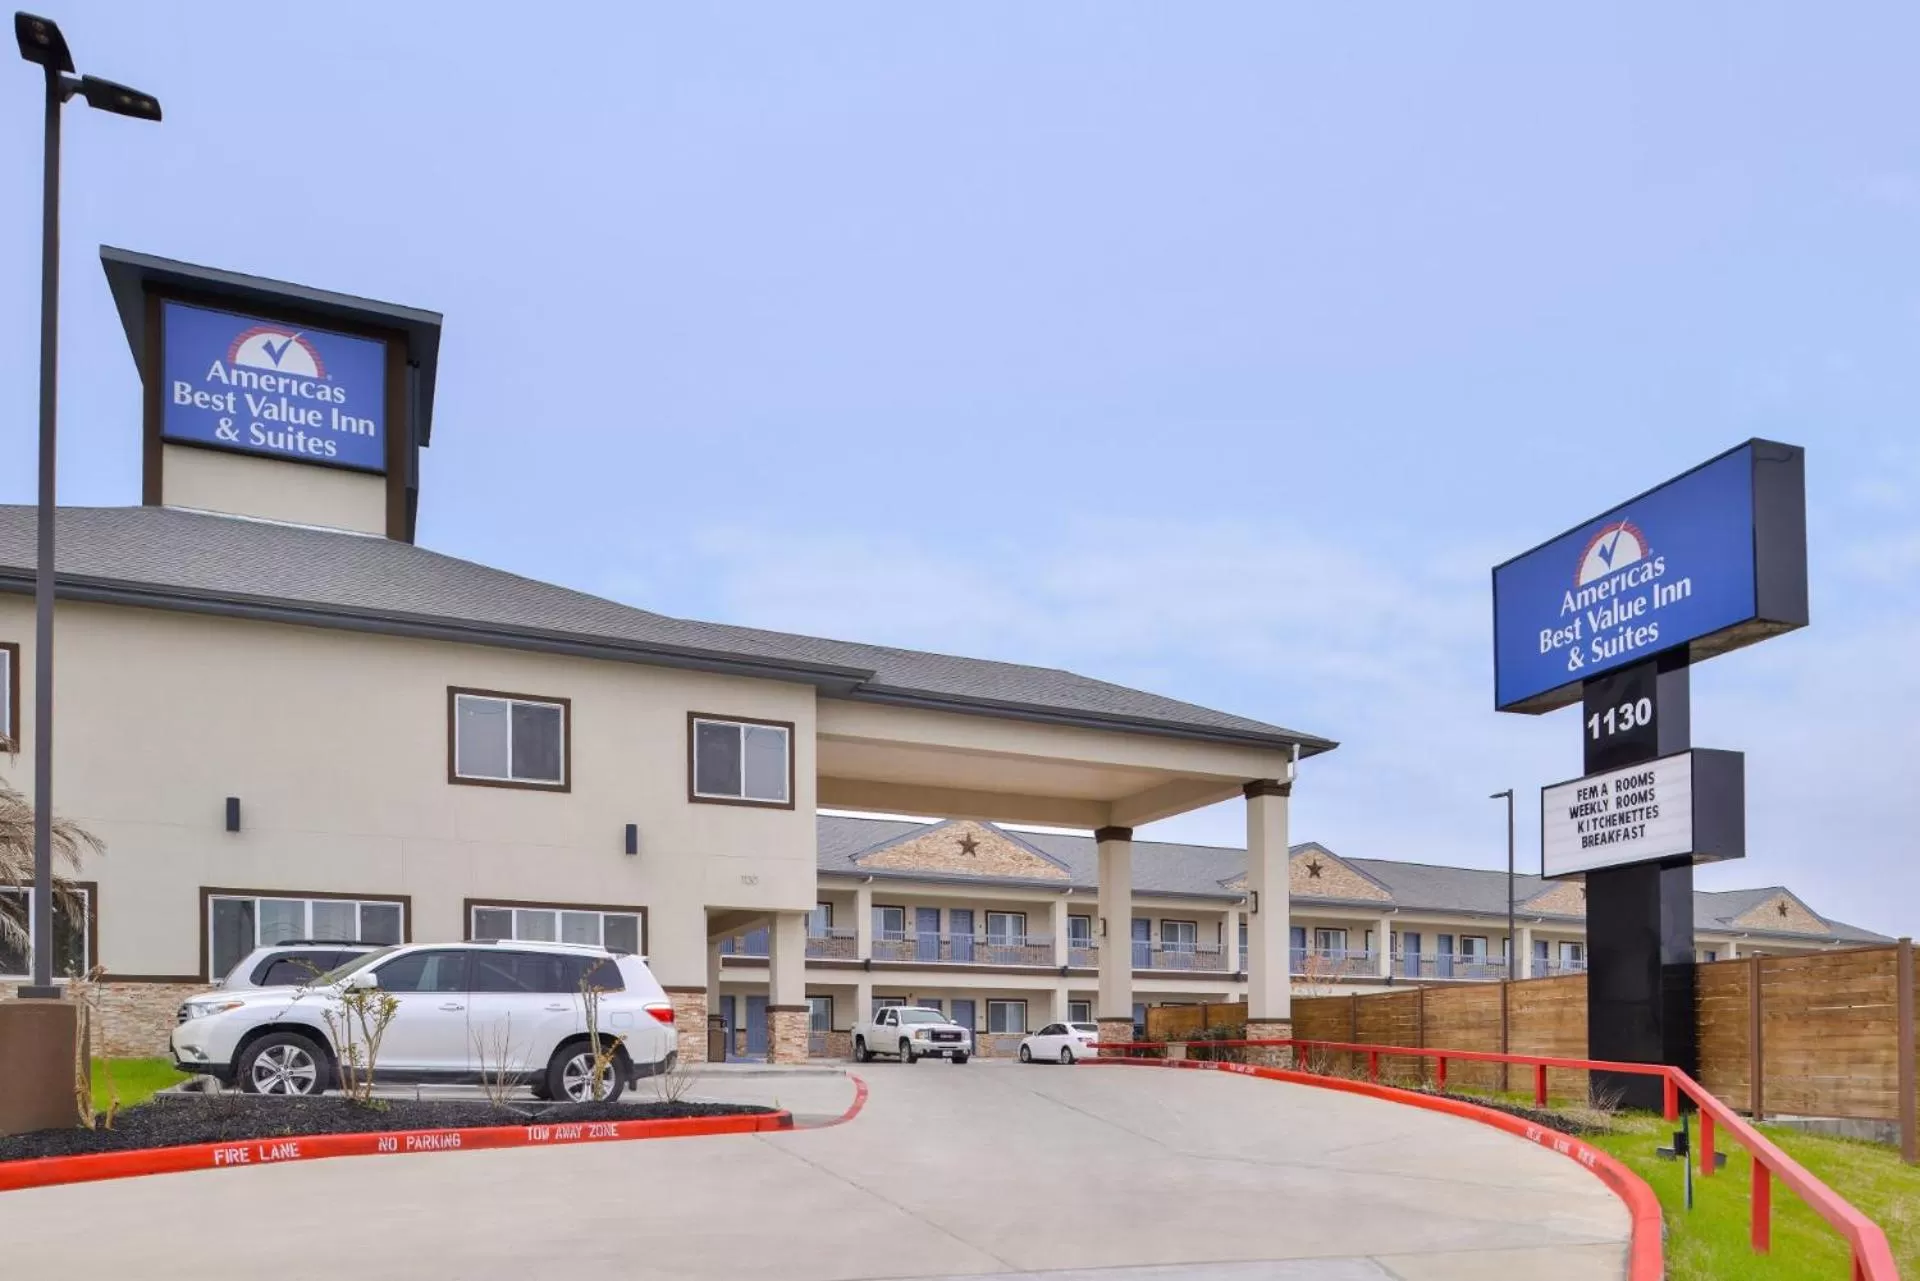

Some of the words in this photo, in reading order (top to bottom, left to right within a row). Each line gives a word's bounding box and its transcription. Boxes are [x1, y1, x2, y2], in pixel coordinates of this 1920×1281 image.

[206, 360, 346, 404] Americas
[173, 380, 236, 414] Best
[244, 393, 323, 428] Value
[331, 407, 375, 437] Inn
[215, 417, 240, 442] &
[249, 421, 337, 457] Suites
[1560, 555, 1665, 617] Americas
[1540, 619, 1582, 654] Best
[1587, 596, 1646, 634] Value
[1653, 576, 1692, 610] Inn
[1567, 646, 1584, 672] &
[1591, 621, 1659, 663] Suites
[1587, 697, 1652, 740] 1130
[1615, 771, 1655, 792] ROOMS
[1569, 799, 1609, 819] WEEKLY
[1616, 788, 1655, 809] ROOMS
[1577, 805, 1659, 834] KITCHENETTES
[1581, 824, 1646, 849] BREAKFAST
[378, 1136, 398, 1152] NO
[406, 1132, 462, 1150] PARKING
[526, 1124, 550, 1141] TOW
[554, 1123, 583, 1140] AWAY
[588, 1122, 620, 1138] ZONE
[214, 1147, 251, 1166] FIRE
[259, 1142, 302, 1161] LANE
